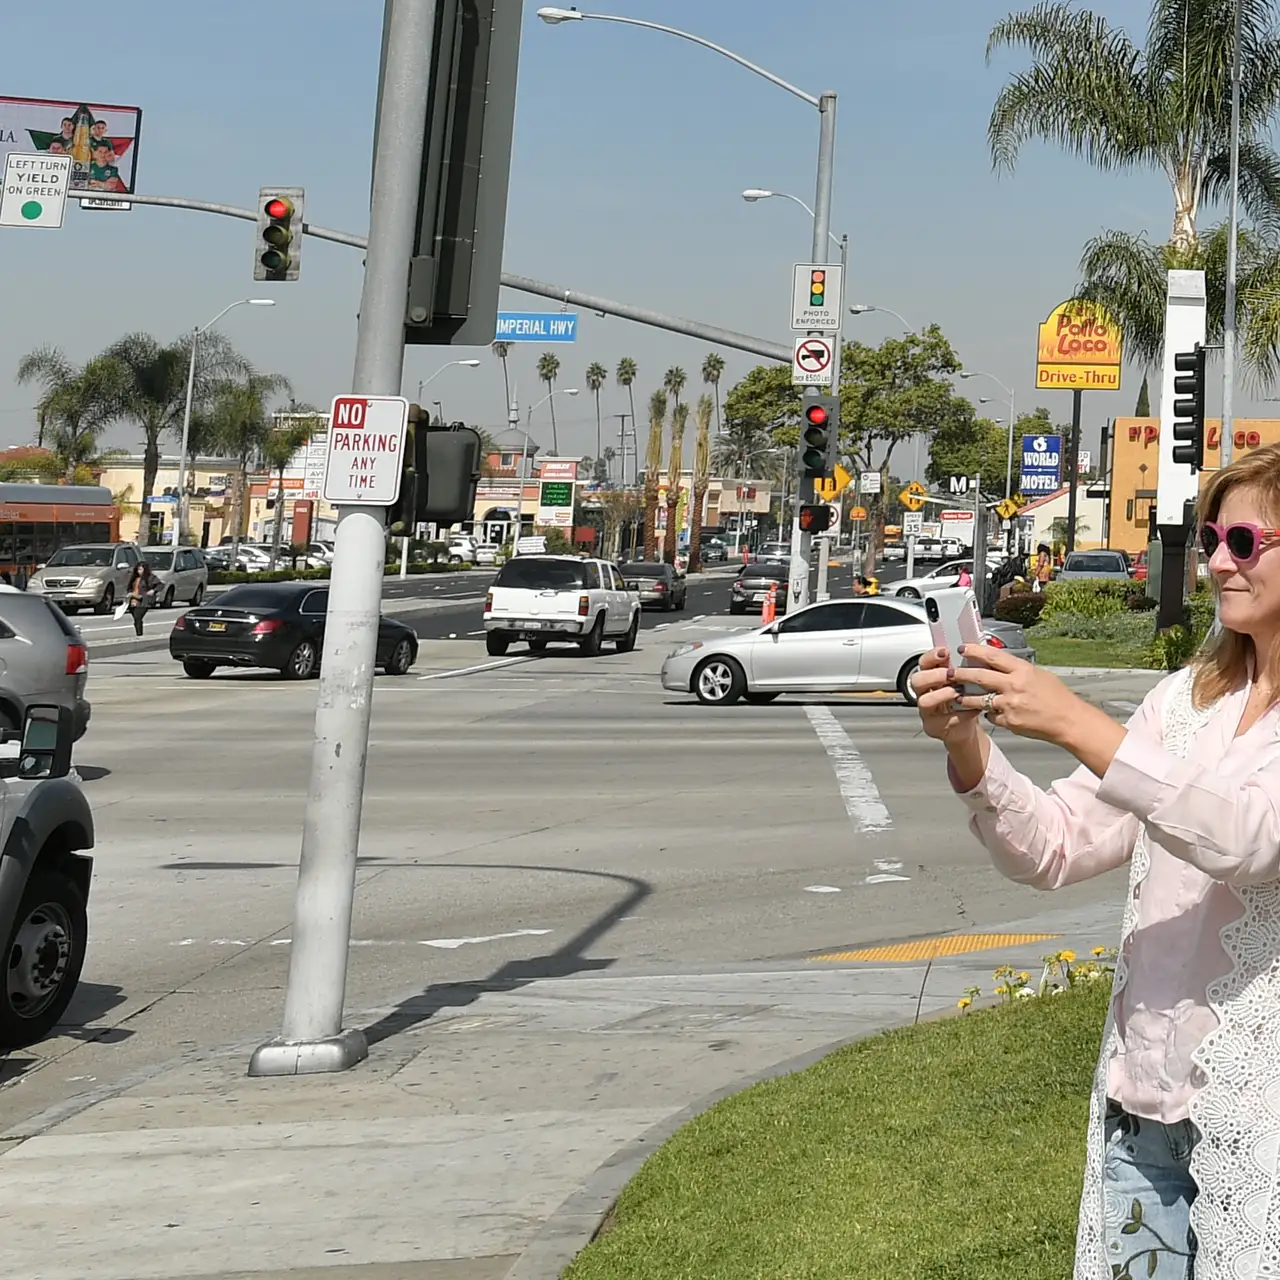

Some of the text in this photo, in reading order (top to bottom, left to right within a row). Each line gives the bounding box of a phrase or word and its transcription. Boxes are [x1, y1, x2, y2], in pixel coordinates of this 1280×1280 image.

[9, 159, 67, 171] LEFT TURN
[17, 172, 59, 183] YIELD
[8, 185, 61, 197] ON GREEN
[496, 319, 574, 336] IMPERIAL HWY
[1057, 333, 1107, 355] Loco
[337, 403, 363, 425] NO
[333, 432, 398, 453] PARKING
[1207, 427, 1260, 449] Lco
[350, 456, 377, 470] ANY
[1023, 451, 1059, 466] WORLD
[348, 474, 376, 488] TIME
[1020, 475, 1058, 489] MOTEL
[905, 524, 920, 532] 35
